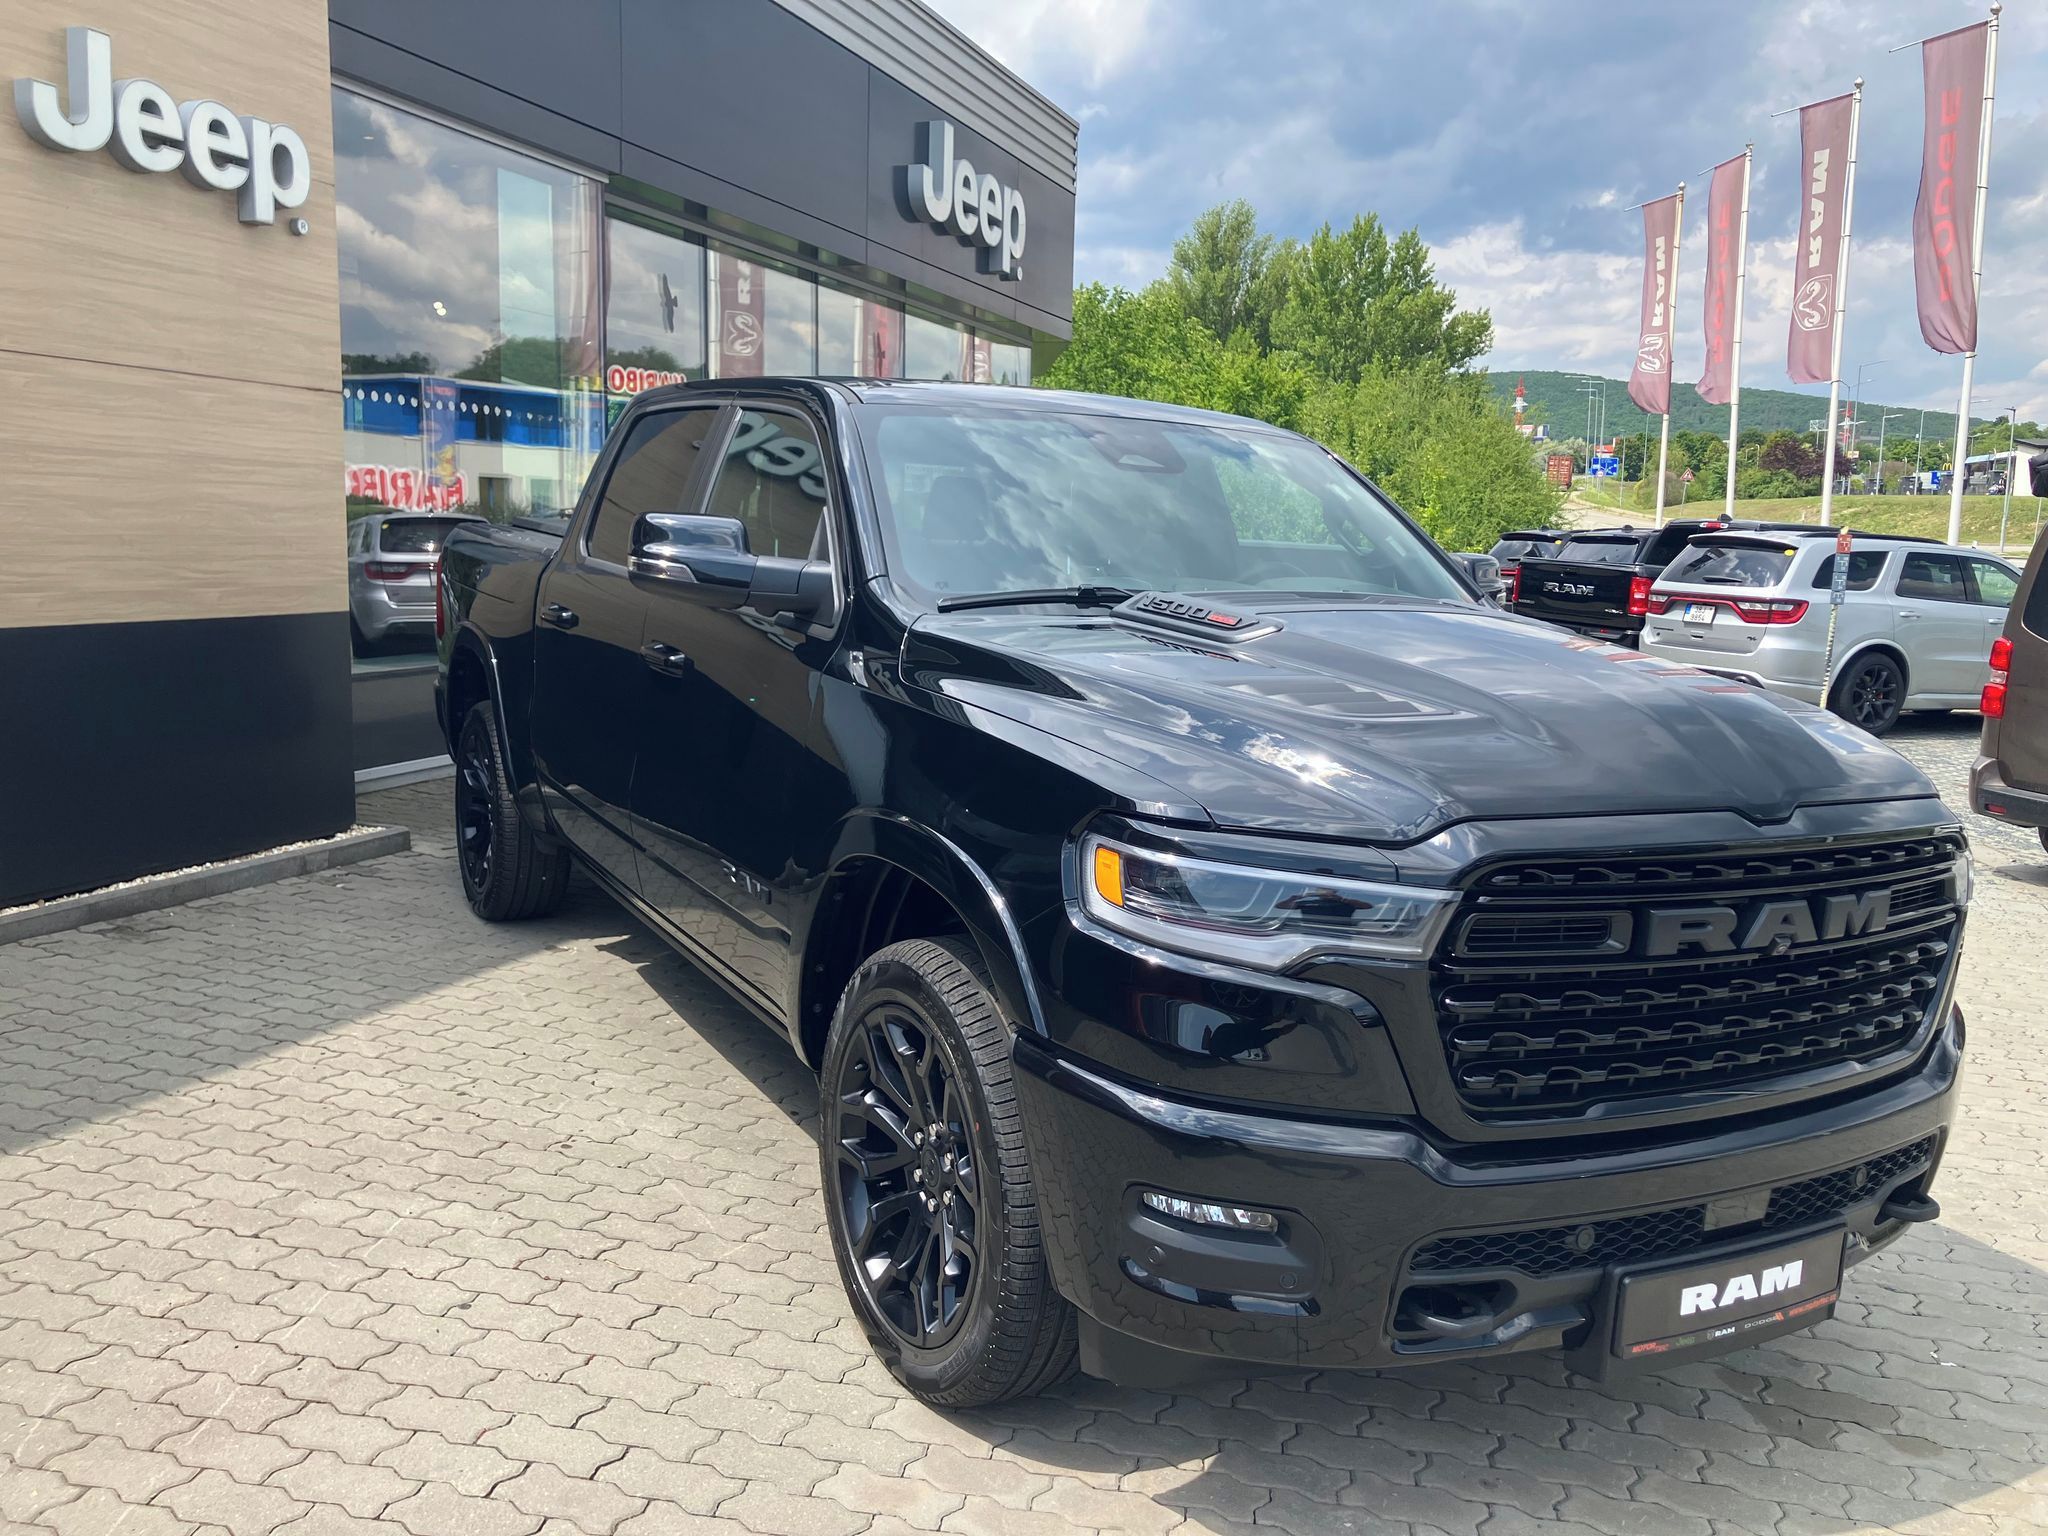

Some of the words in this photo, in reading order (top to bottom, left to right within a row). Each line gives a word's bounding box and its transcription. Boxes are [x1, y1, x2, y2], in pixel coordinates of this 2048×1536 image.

[14, 26, 311, 226] Jeep
[908, 119, 1027, 274] Jeep
[1142, 595, 1212, 620] 1500
[1542, 581, 1595, 596] RAM
[1645, 889, 1898, 957] RAM
[1680, 1259, 1803, 1316] RAM
[1715, 1327, 1735, 1337] RAM
